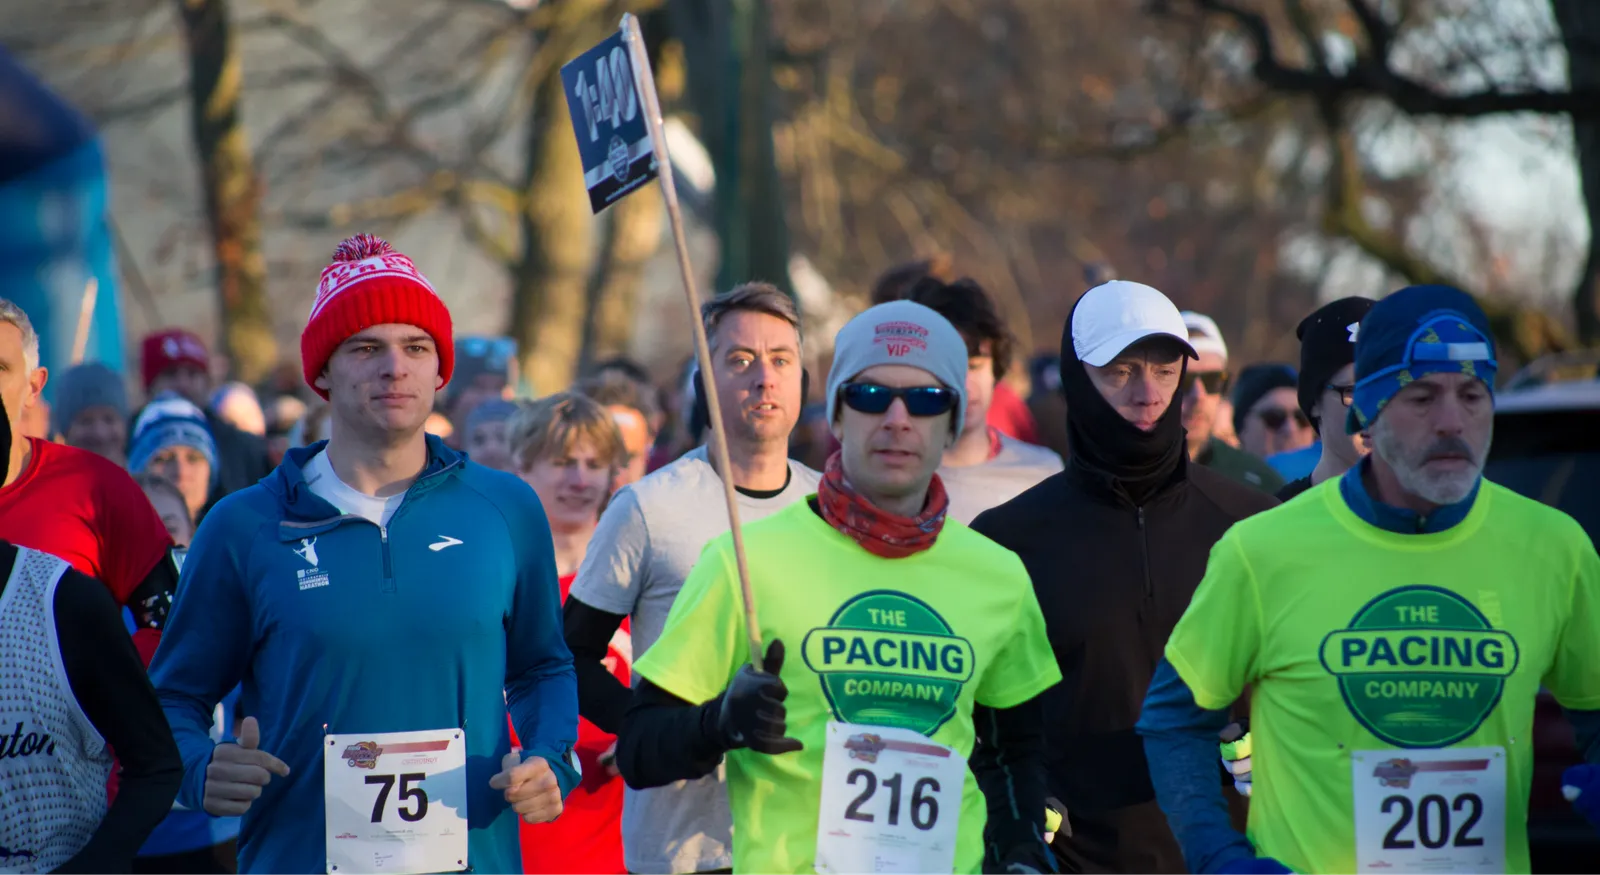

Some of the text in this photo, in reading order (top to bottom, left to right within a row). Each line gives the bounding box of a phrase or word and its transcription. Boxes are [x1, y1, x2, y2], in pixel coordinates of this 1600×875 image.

[575, 46, 637, 142] 1:40
[887, 343, 911, 357] VIP
[867, 608, 907, 628] THE
[1394, 605, 1439, 623] THE
[822, 636, 964, 674] PACING
[1341, 636, 1505, 668] PACING
[844, 678, 944, 702] COMPANY
[1365, 680, 1480, 699] COMPANY
[364, 772, 429, 823] 75
[844, 768, 941, 831] 216
[1380, 792, 1485, 850] 202
